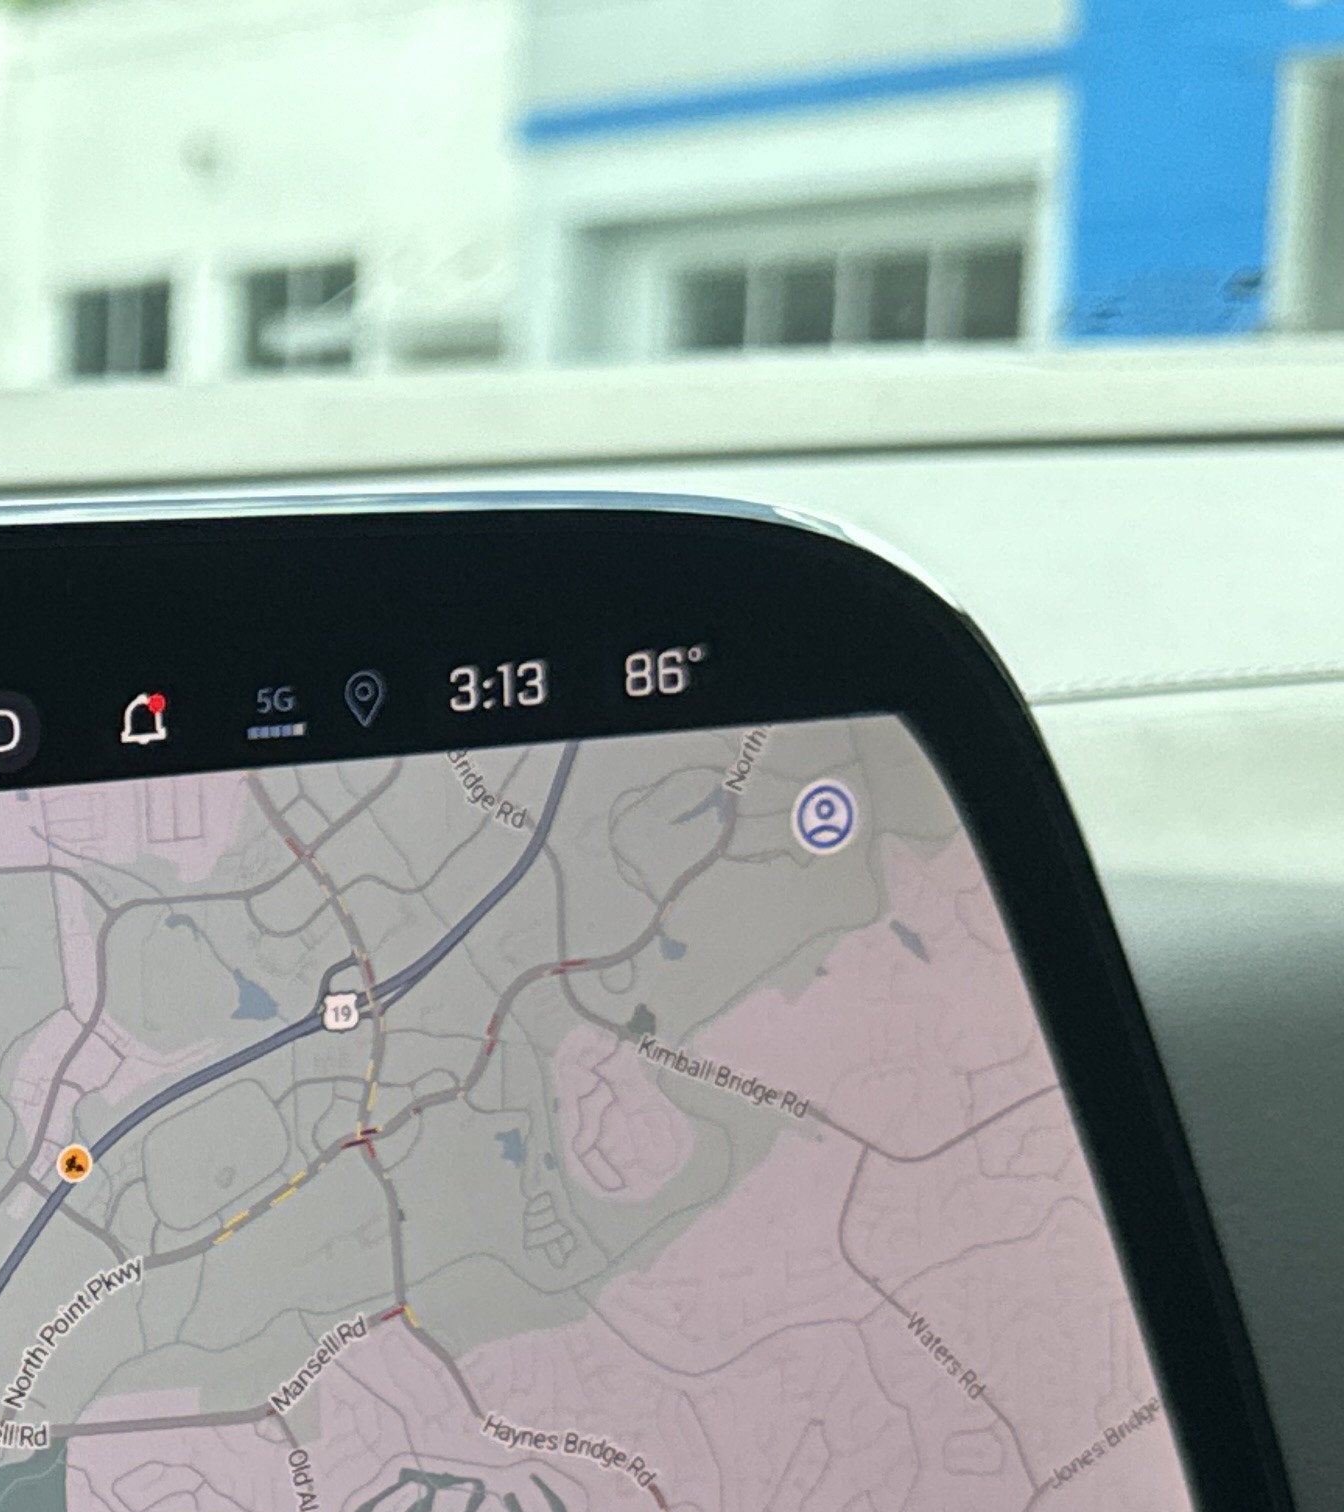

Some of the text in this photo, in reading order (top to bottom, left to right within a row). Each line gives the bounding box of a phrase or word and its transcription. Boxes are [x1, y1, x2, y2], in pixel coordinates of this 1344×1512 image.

[256, 686, 294, 714] 5G
[449, 660, 547, 712] 3:13
[496, 801, 527, 829] Rd
[330, 1001, 353, 1022] 19
[638, 1034, 810, 1119] Kimball Bridge Rd
[3, 1259, 142, 1409] North Point Pkwy
[908, 1313, 985, 1399] Waters Rd
[270, 1317, 367, 1412] Mansell Rd
[16, 1424, 47, 1446] Rd
[483, 1416, 655, 1487] Haynes Bridge Rd
[288, 1449, 314, 1487] Old
